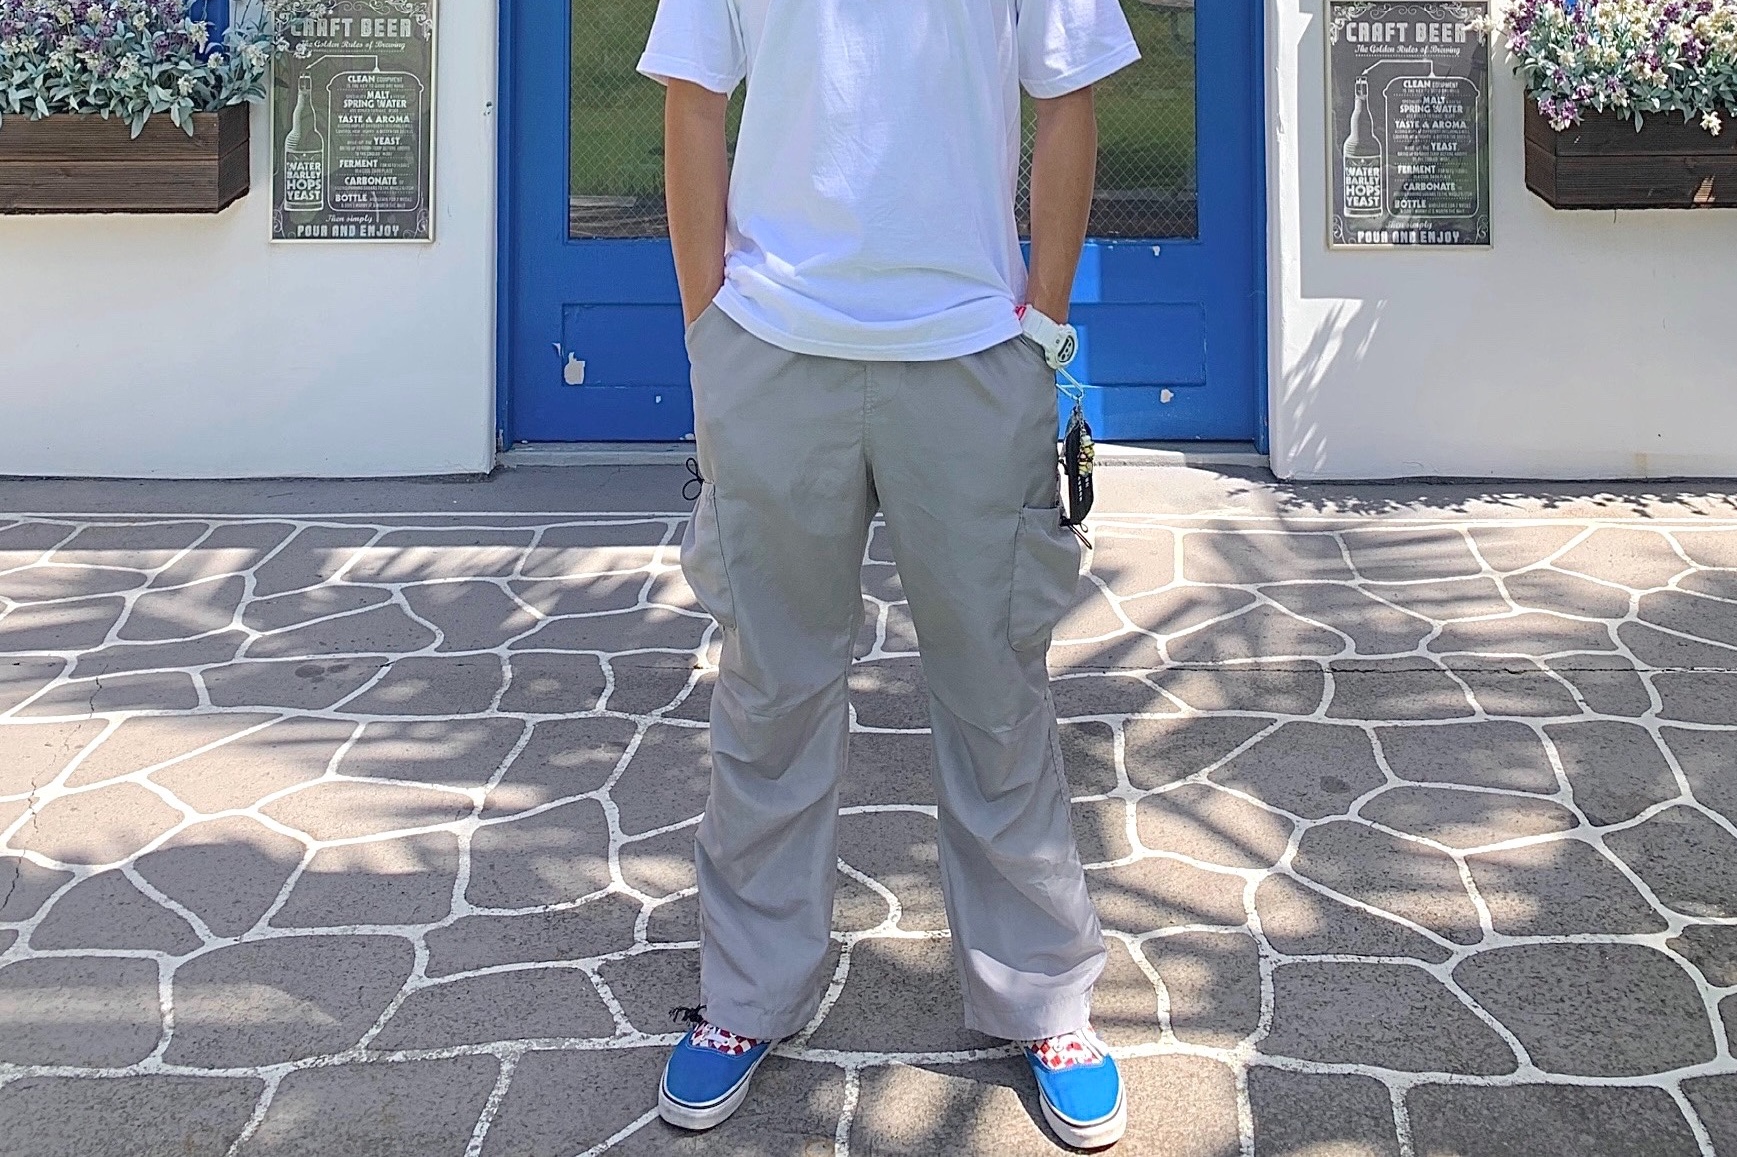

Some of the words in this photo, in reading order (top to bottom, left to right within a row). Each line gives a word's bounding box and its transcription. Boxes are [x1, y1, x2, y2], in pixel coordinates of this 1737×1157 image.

[361, 18, 411, 37] BEER
[1346, 22, 1408, 42] CRAFT
[1416, 22, 1466, 42] BEER
[364, 41, 372, 50] of
[374, 41, 405, 50] Brewing
[1420, 45, 1427, 55] of
[1429, 45, 1460, 55] Brewing
[286, 162, 321, 171] WATER
[1345, 167, 1379, 176] WATER
[1398, 165, 1436, 174] FERMENT
[286, 180, 321, 190] HOPS
[287, 191, 320, 200] YEAST
[1346, 186, 1380, 196] HOPS
[1346, 197, 1379, 206] YEAST
[1394, 200, 1426, 208] BOTTLE
[347, 214, 373, 224] simply
[297, 226, 328, 237] POUR
[332, 226, 356, 237] AND
[360, 226, 399, 237] ENJOY
[1358, 231, 1388, 243] POUR
[1392, 231, 1416, 243] AND
[1421, 231, 1460, 243] ENJOY
